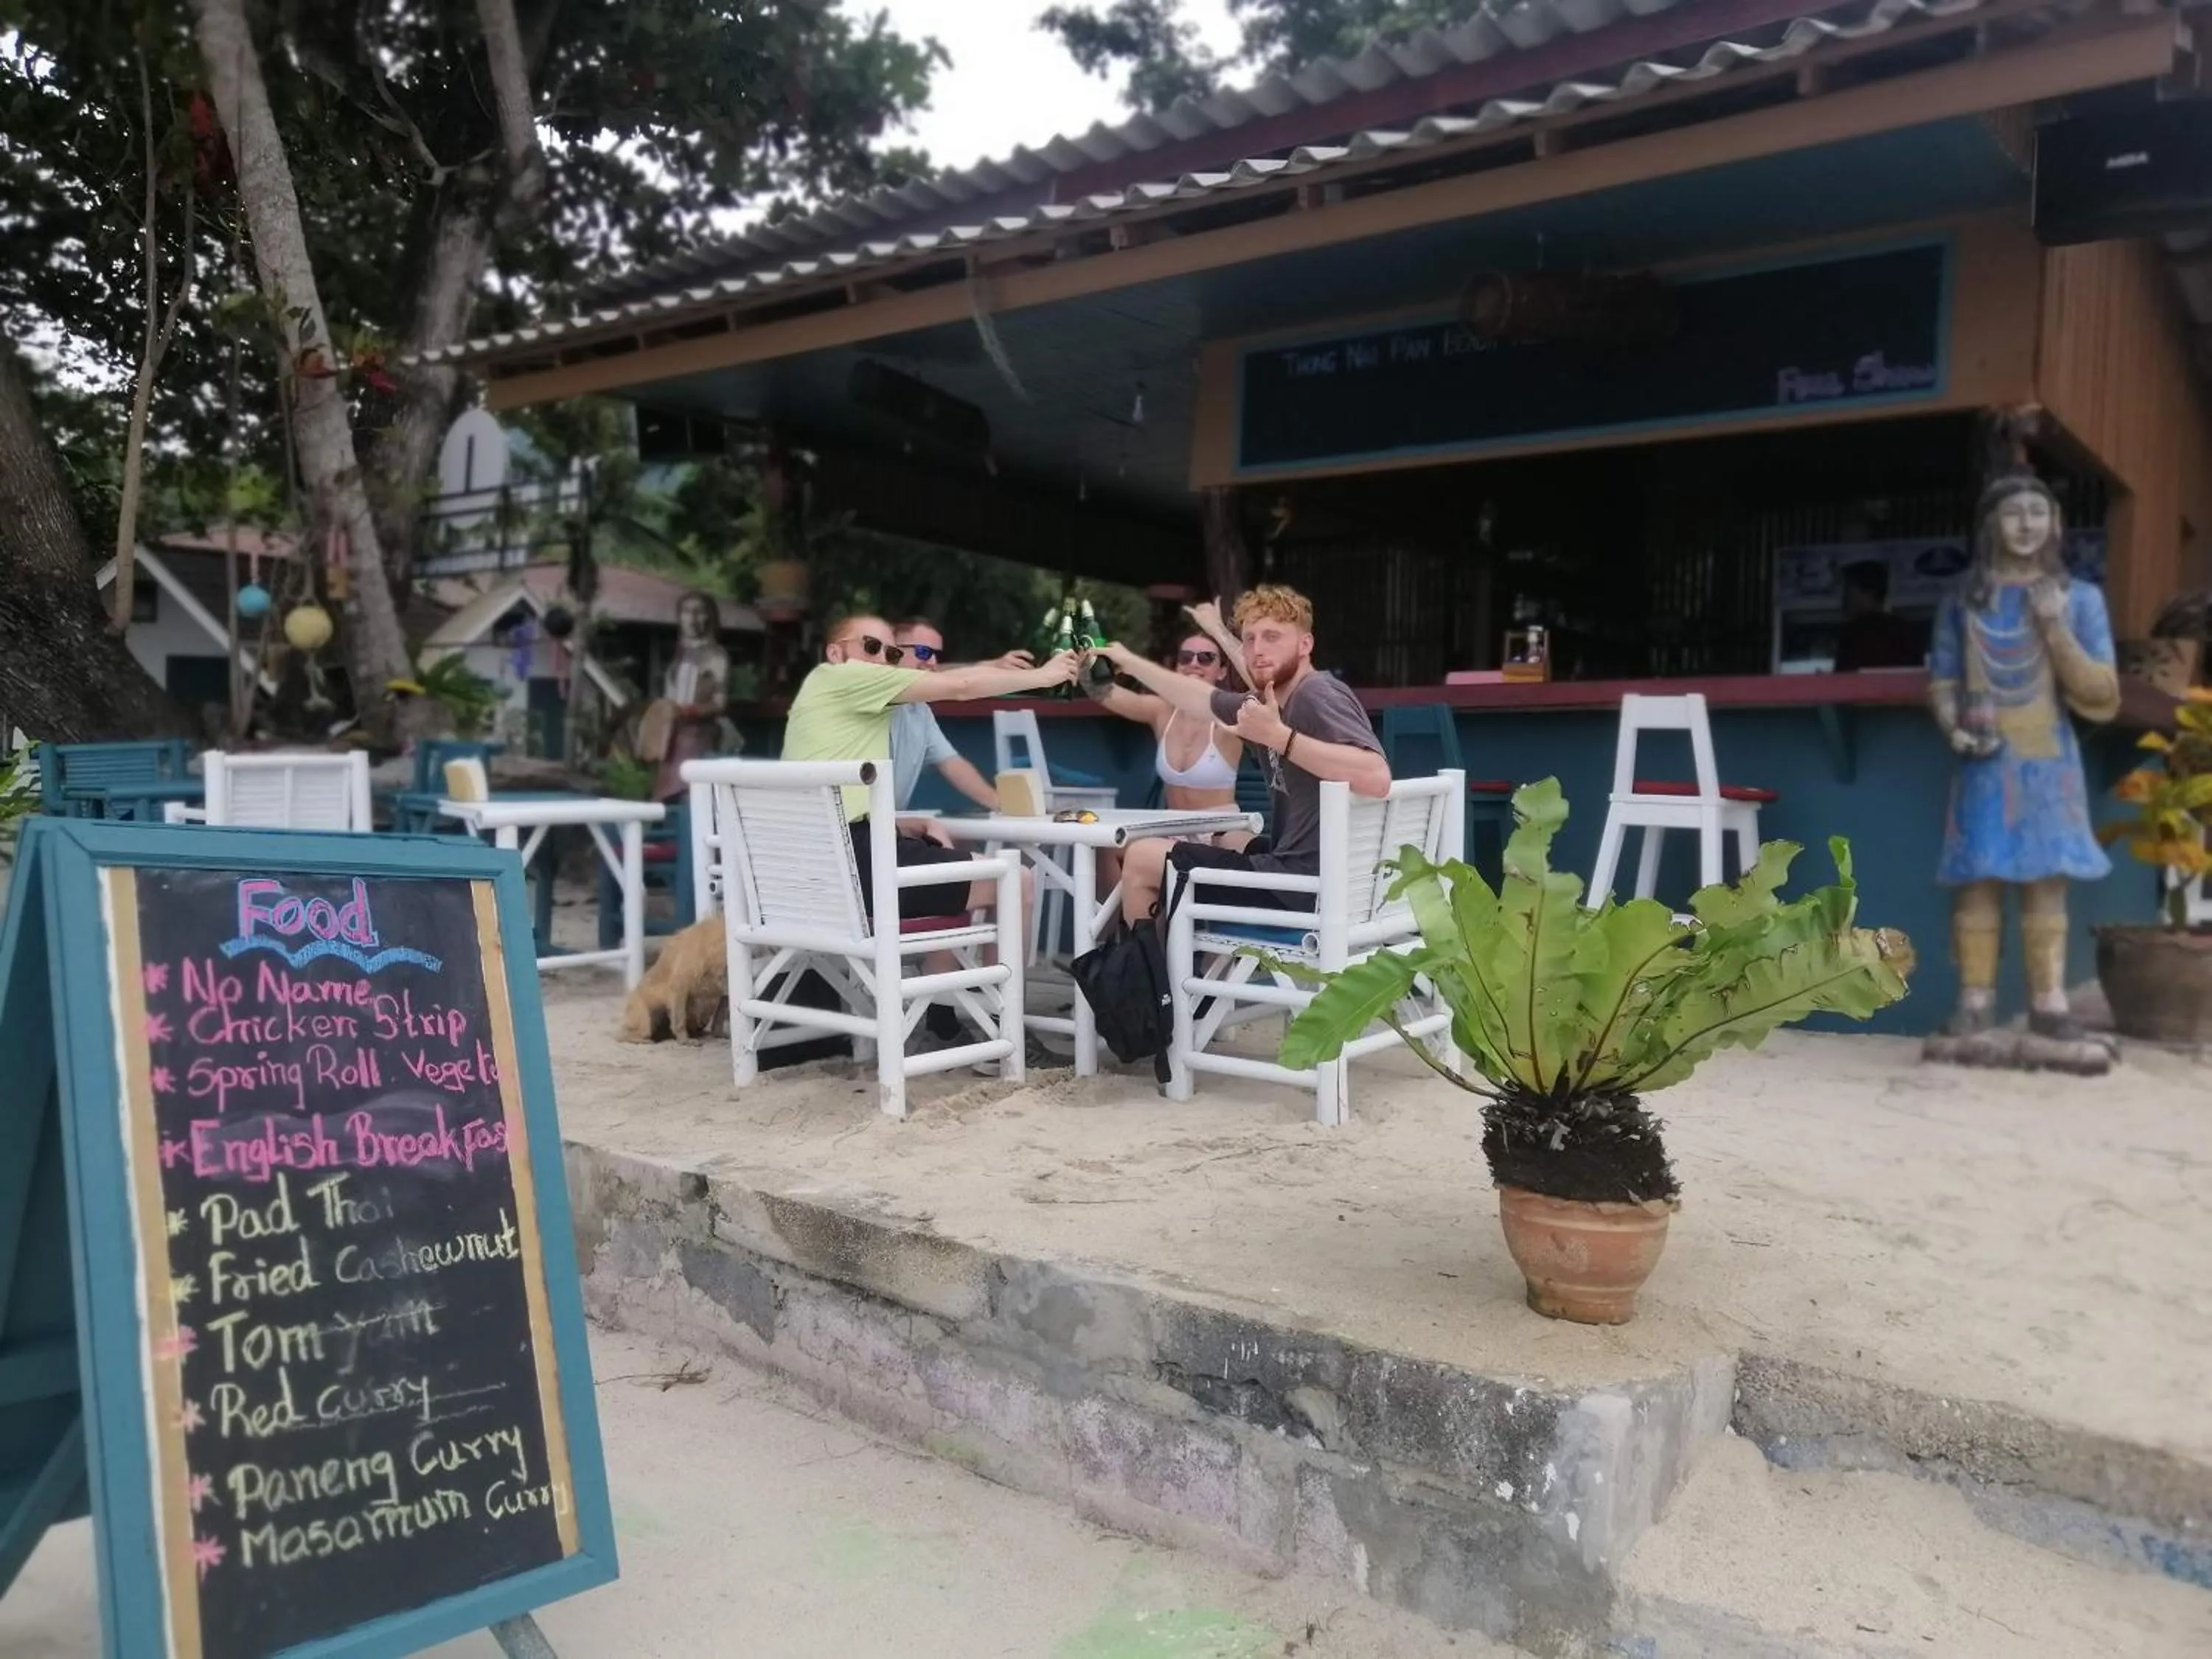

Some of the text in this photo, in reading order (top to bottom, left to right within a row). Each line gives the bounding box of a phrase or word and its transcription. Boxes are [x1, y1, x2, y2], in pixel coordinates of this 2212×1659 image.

[237, 877, 379, 947] Food
[182, 957, 371, 1006] No Name
[187, 989, 467, 1047] Chicken Strip
[187, 1051, 303, 1110] Spring
[307, 1043, 382, 1091] Roll
[190, 1116, 340, 1180] English
[202, 1170, 395, 1244] Pad Thai
[210, 1234, 321, 1304] Fried
[207, 1310, 325, 1373] Tom
[211, 1367, 305, 1438] Red
[228, 1425, 529, 1520] Paneng Curry
[485, 1480, 568, 1522] Curry
